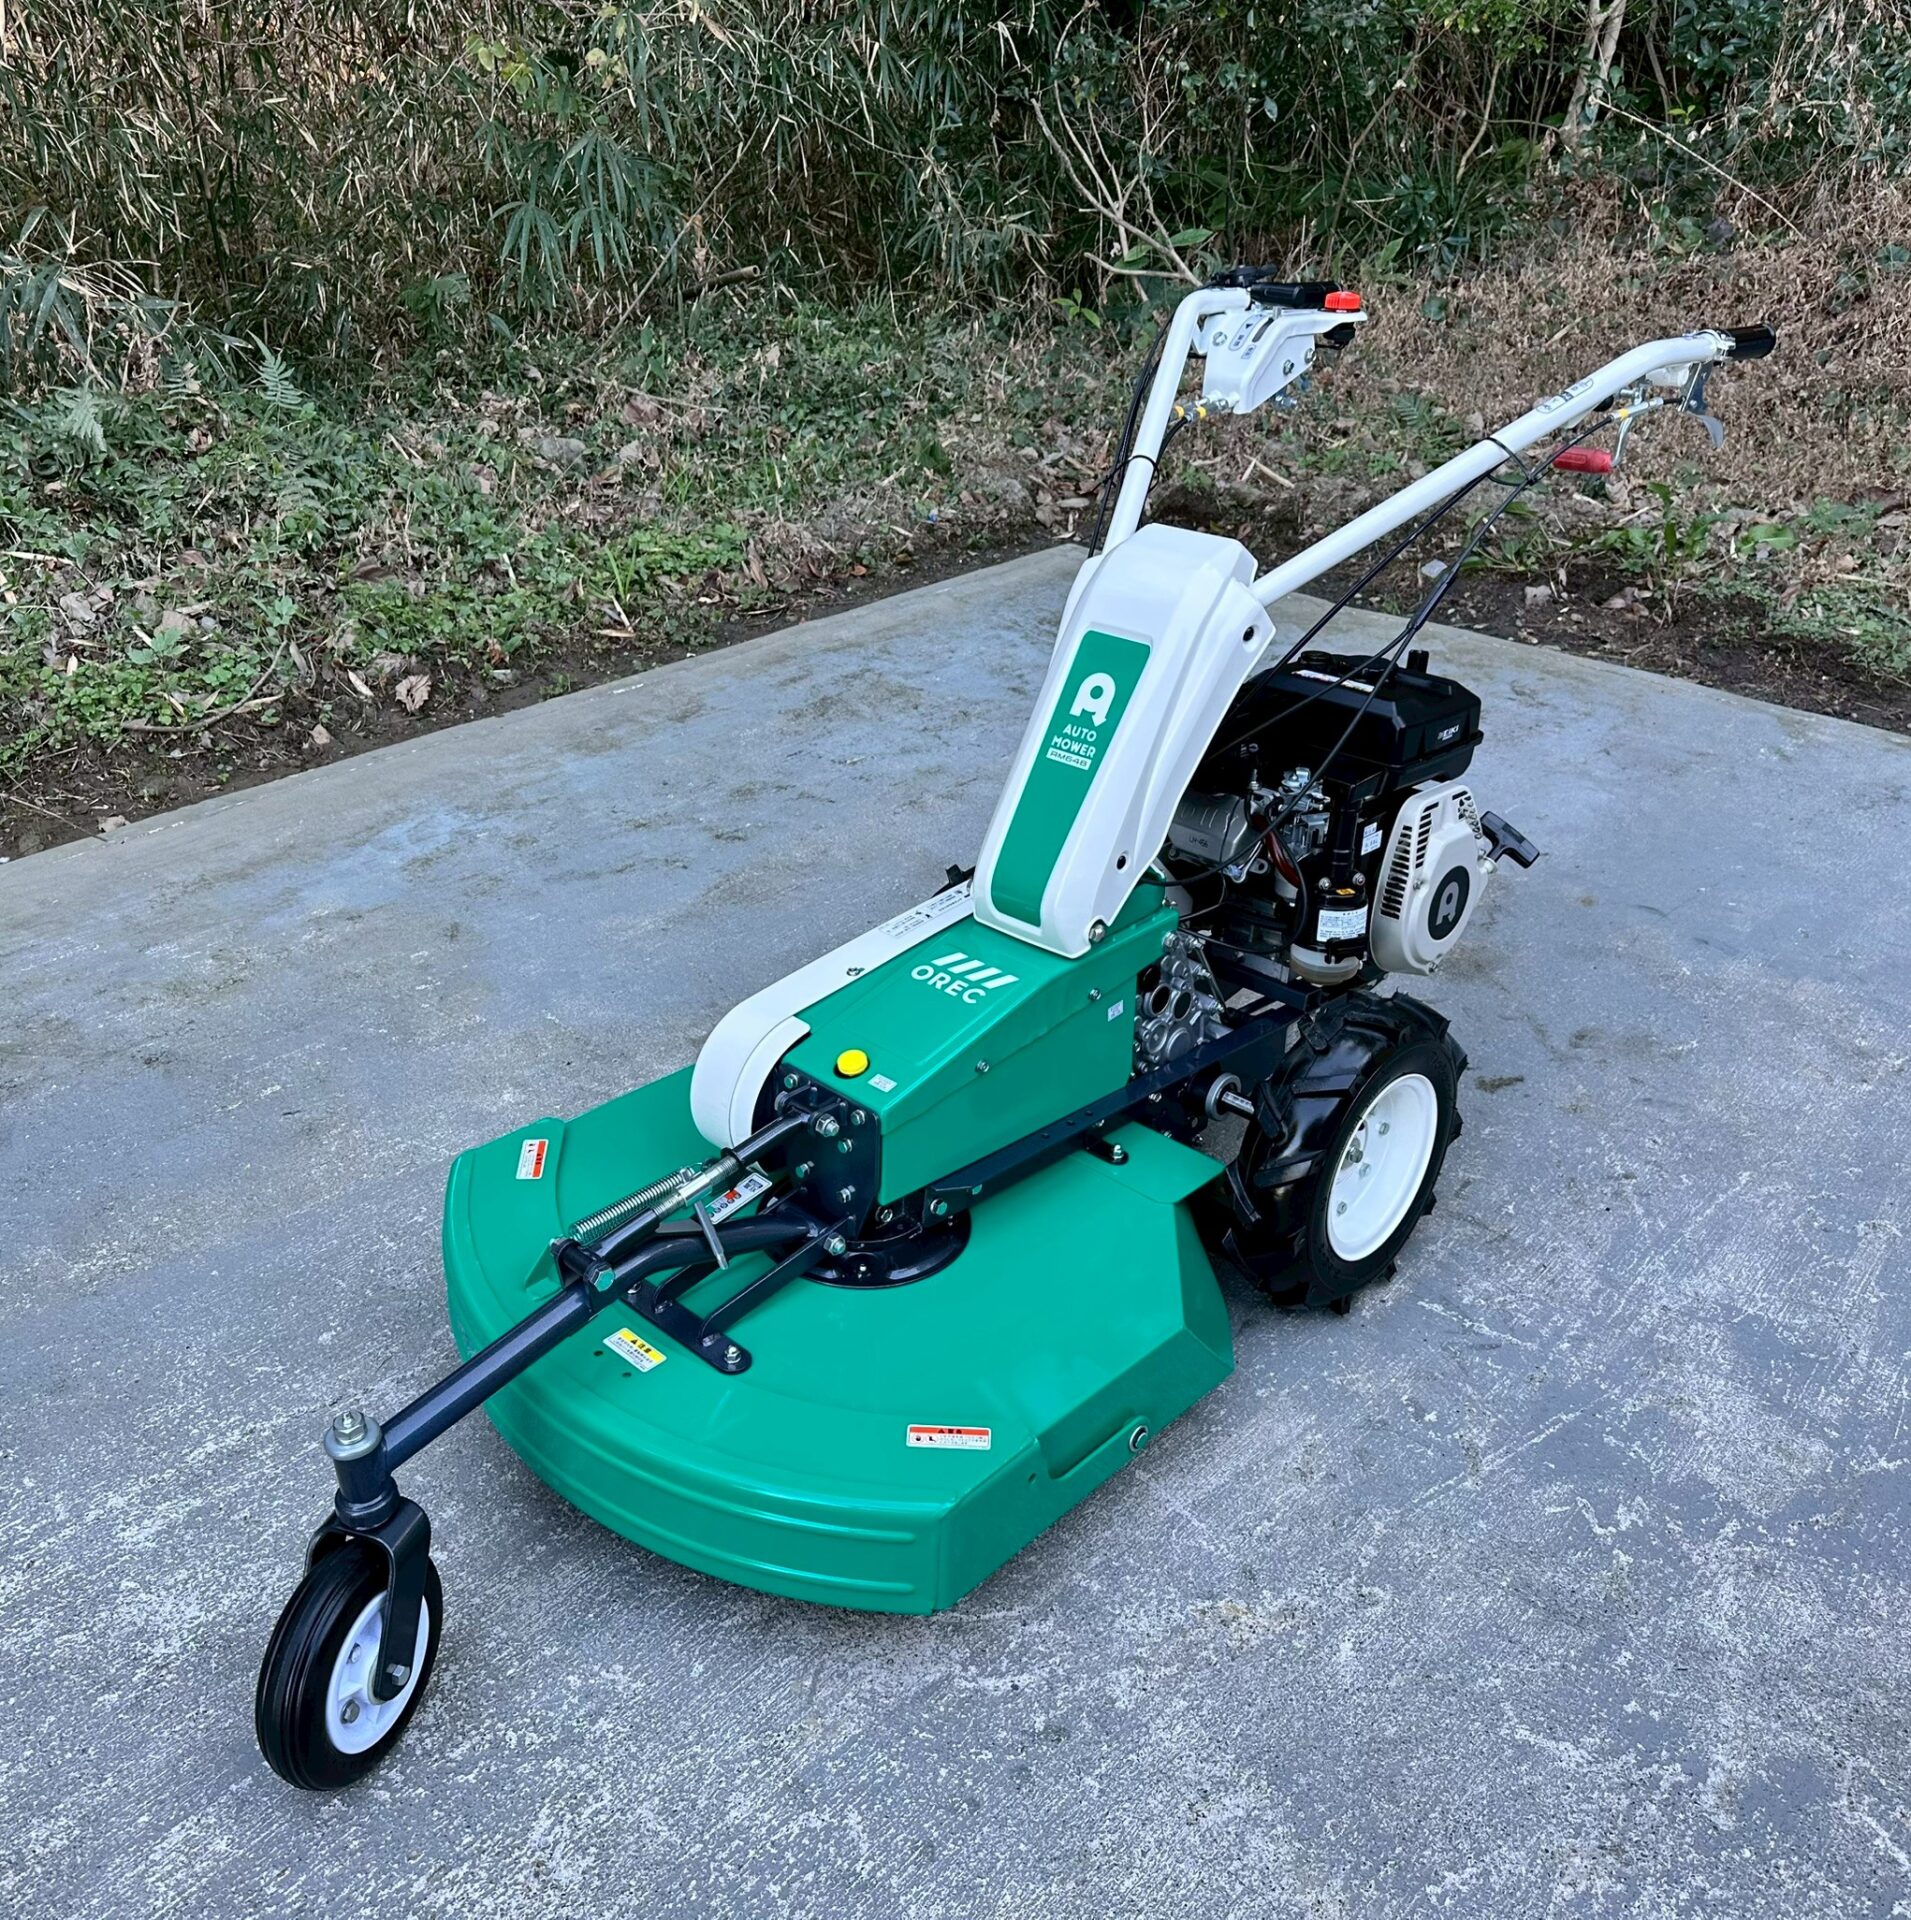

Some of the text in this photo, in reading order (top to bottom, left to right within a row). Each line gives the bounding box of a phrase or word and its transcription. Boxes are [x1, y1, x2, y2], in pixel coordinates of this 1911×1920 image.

[1062, 723, 1097, 742] AUTO
[1050, 735, 1096, 758] MOWER
[911, 965, 986, 1004] OREC
